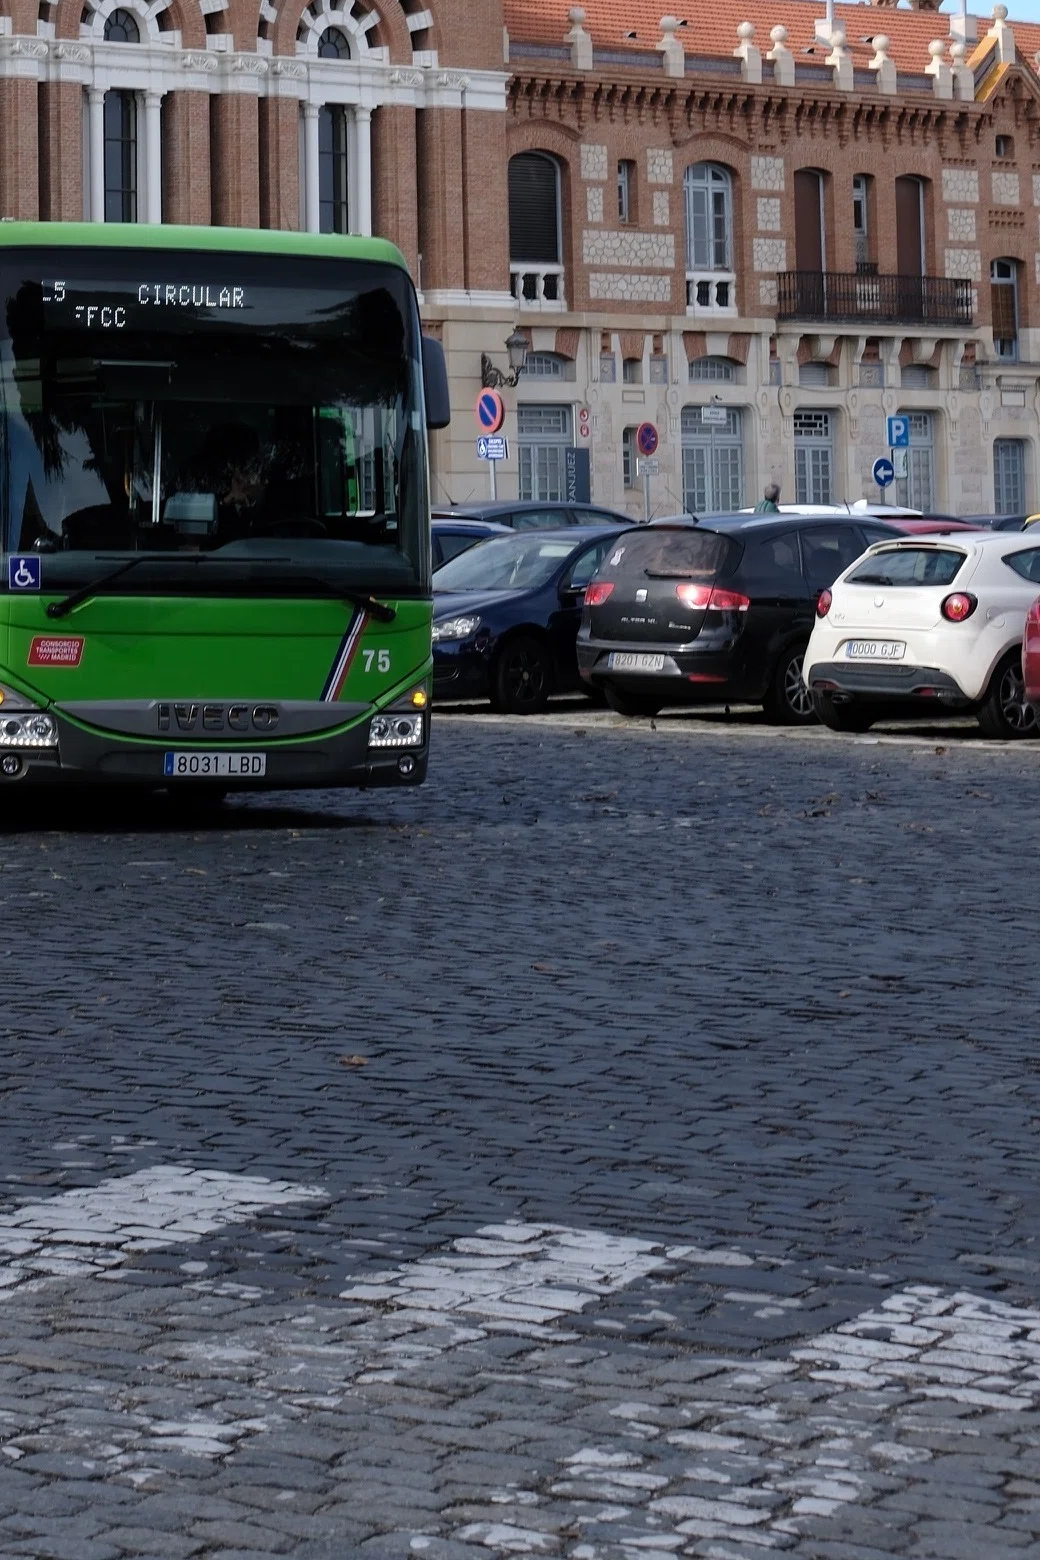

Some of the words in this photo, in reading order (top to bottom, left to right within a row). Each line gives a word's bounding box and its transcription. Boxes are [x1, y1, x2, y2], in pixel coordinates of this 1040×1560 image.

[138, 284, 244, 307] CIRCULAR
[891, 420, 904, 444] P
[36, 646, 78, 654] TRANSPORTES
[40, 640, 80, 648] CONSORCIO
[853, 642, 876, 655] 0000
[881, 644, 901, 656] GJF
[51, 653, 76, 661] MADRID
[362, 649, 391, 673] 75
[615, 654, 637, 666] 8201
[641, 655, 661, 667] GZN
[158, 703, 280, 731] IVECO
[178, 756, 219, 773] 8031
[228, 756, 261, 773] LBD
